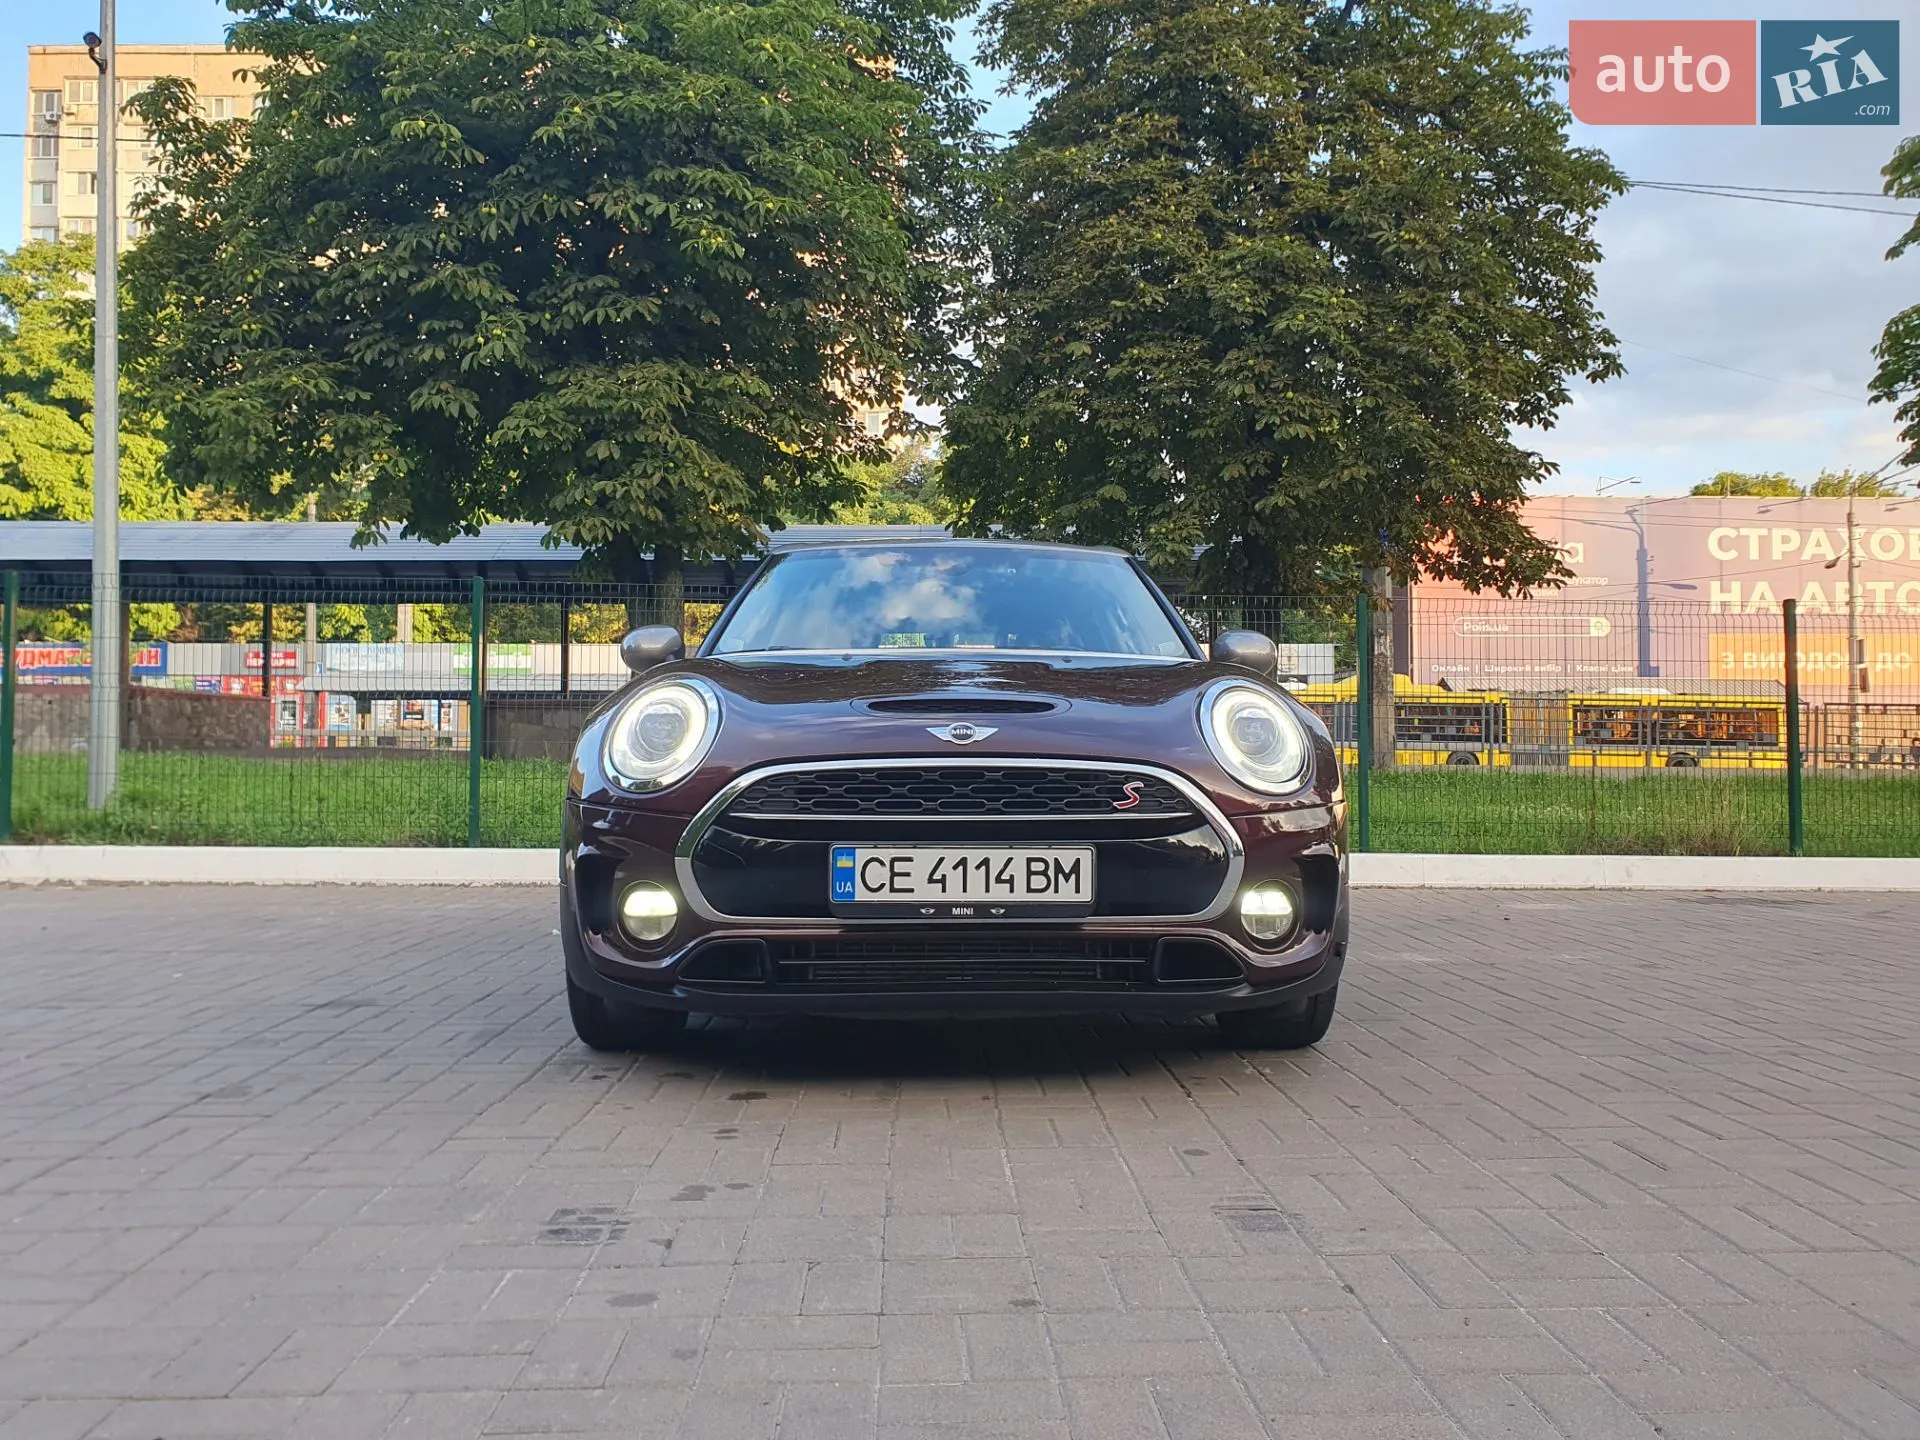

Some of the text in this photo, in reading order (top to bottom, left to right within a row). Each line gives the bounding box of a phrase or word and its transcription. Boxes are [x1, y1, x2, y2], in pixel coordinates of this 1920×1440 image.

[1710, 581, 1781, 614] НА
[1431, 664, 1470, 673] Онлайн
[951, 728, 974, 736] MINI
[1113, 781, 1144, 809] S
[860, 856, 1081, 894] CE 4114 BM
[836, 881, 853, 894] UA
[952, 907, 974, 916] MINI
